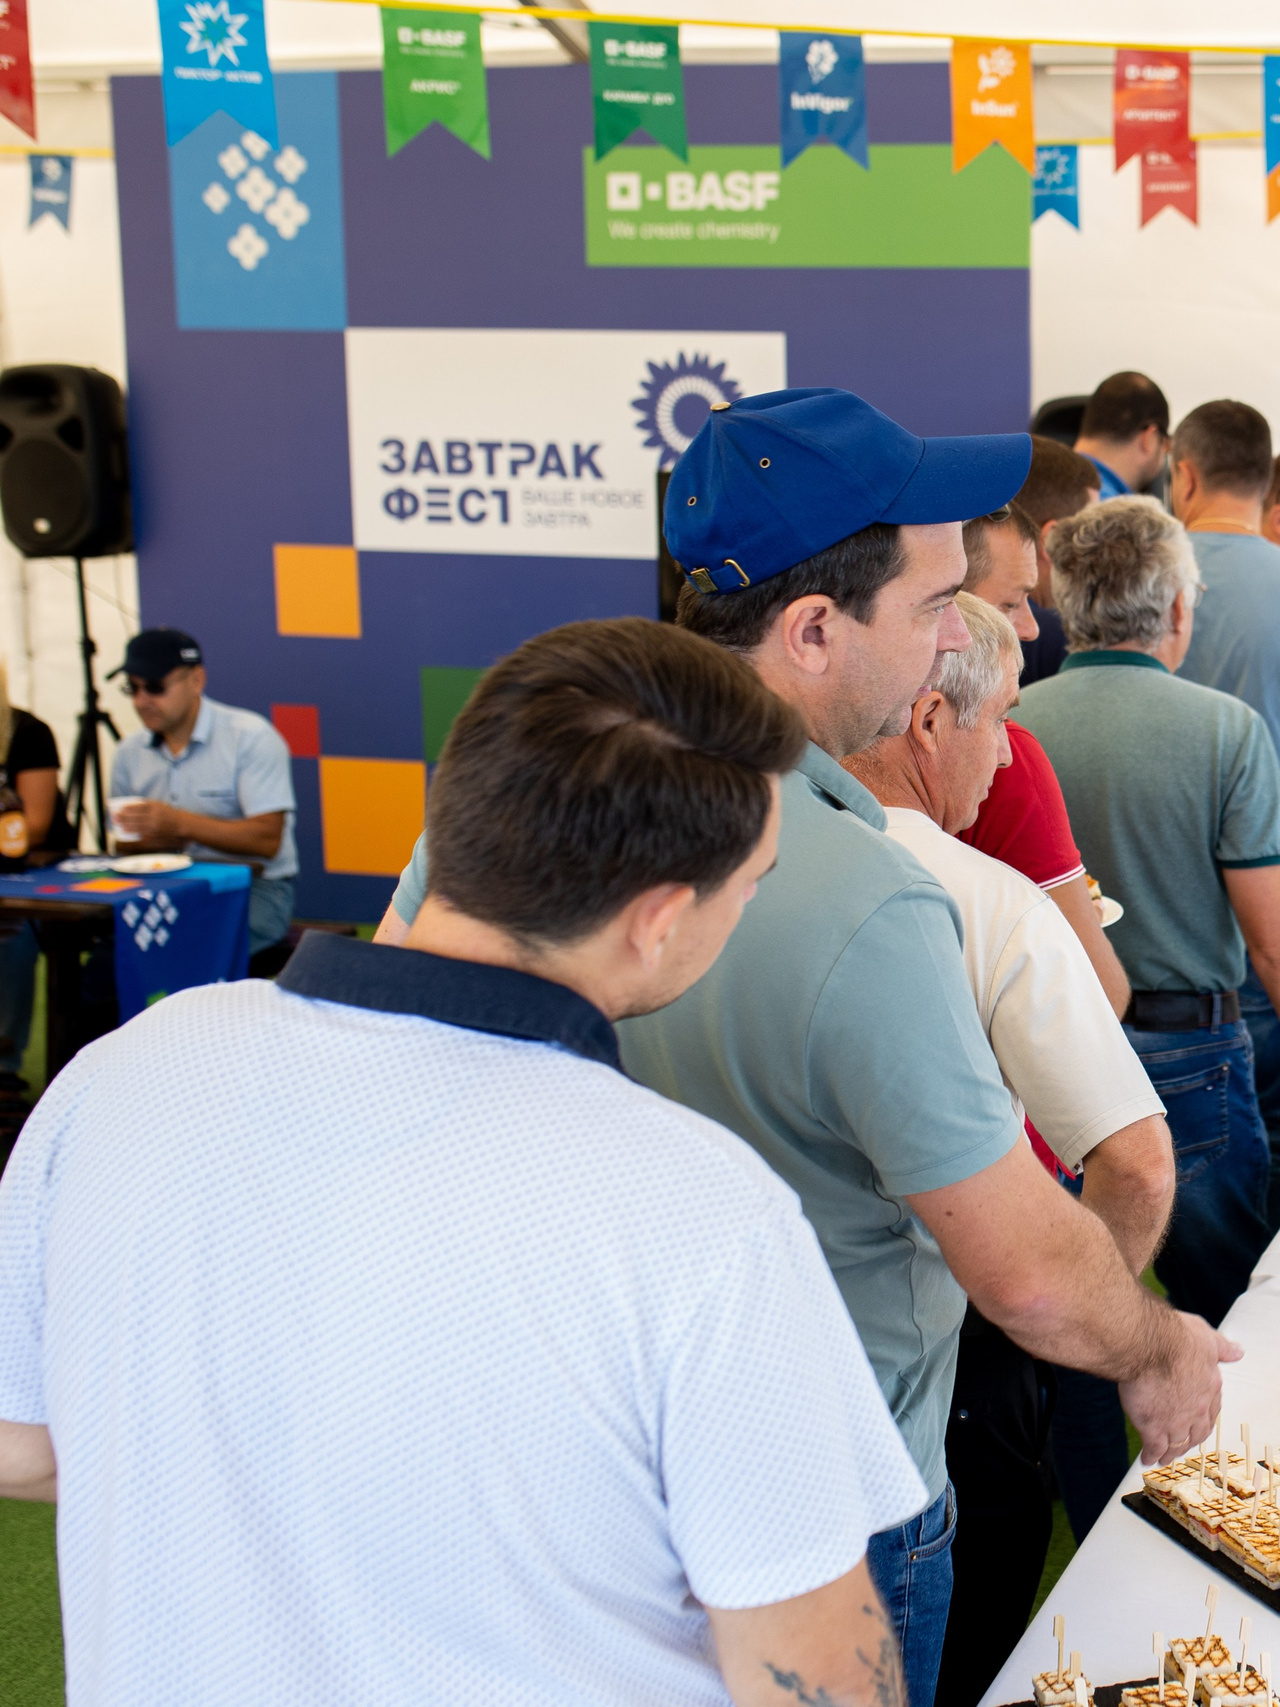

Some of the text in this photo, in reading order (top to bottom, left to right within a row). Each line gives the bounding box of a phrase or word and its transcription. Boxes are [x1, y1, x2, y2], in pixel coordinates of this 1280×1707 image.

[421, 28, 466, 48] BASF
[625, 41, 667, 58] BASF
[790, 91, 849, 114] InVigor
[971, 99, 1016, 117] InSun
[666, 170, 780, 211] BASF
[607, 217, 781, 245] We create chemistry
[379, 438, 605, 480] ЗАВТРАК
[521, 487, 647, 510] ВАШЕ НОВОЕ
[521, 508, 592, 529] ЗАВТРА
